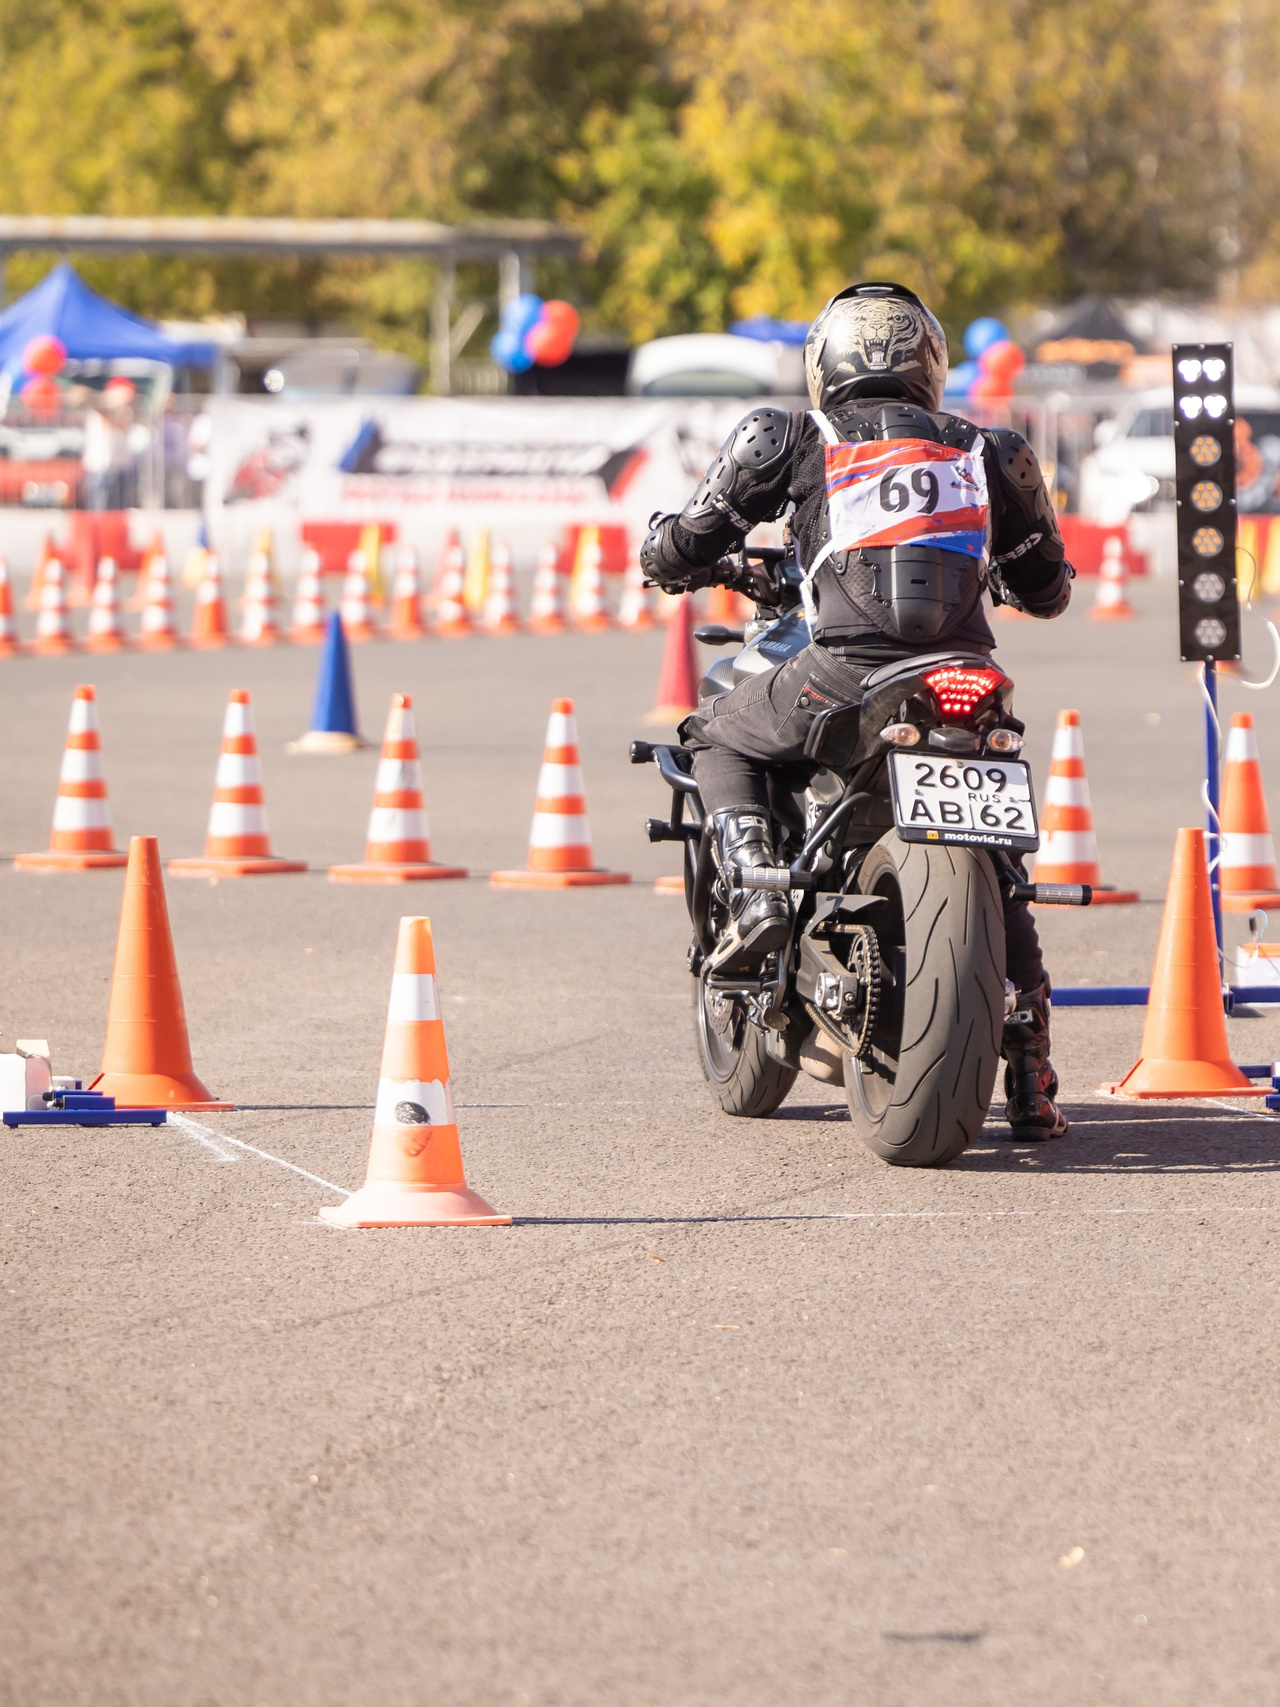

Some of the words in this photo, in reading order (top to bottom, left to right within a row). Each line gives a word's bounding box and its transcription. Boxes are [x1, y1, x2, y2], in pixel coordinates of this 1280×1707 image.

[878, 466, 940, 515] 69
[914, 762, 1008, 792] 2609
[968, 792, 1002, 804] RUS
[980, 804, 1026, 831] 62
[944, 832, 1013, 846] motovid.ru
